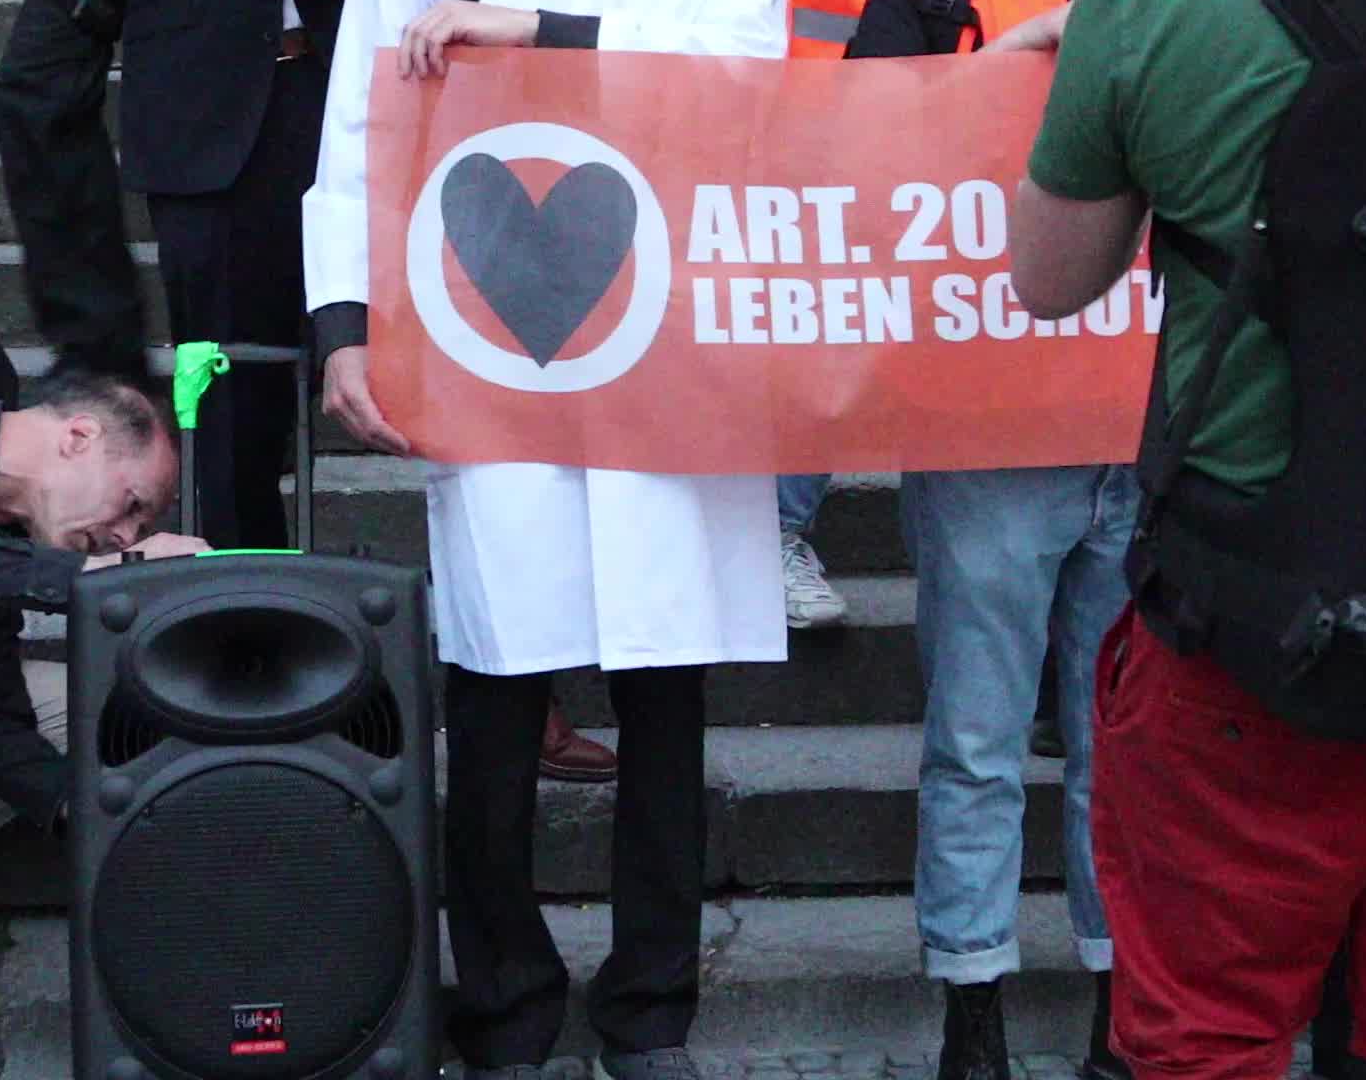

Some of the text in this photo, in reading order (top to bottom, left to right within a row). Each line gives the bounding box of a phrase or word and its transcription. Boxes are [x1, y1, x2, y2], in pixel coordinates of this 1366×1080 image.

[687, 179, 1007, 265] ART. 20
[691, 274, 914, 345] LEBEN
